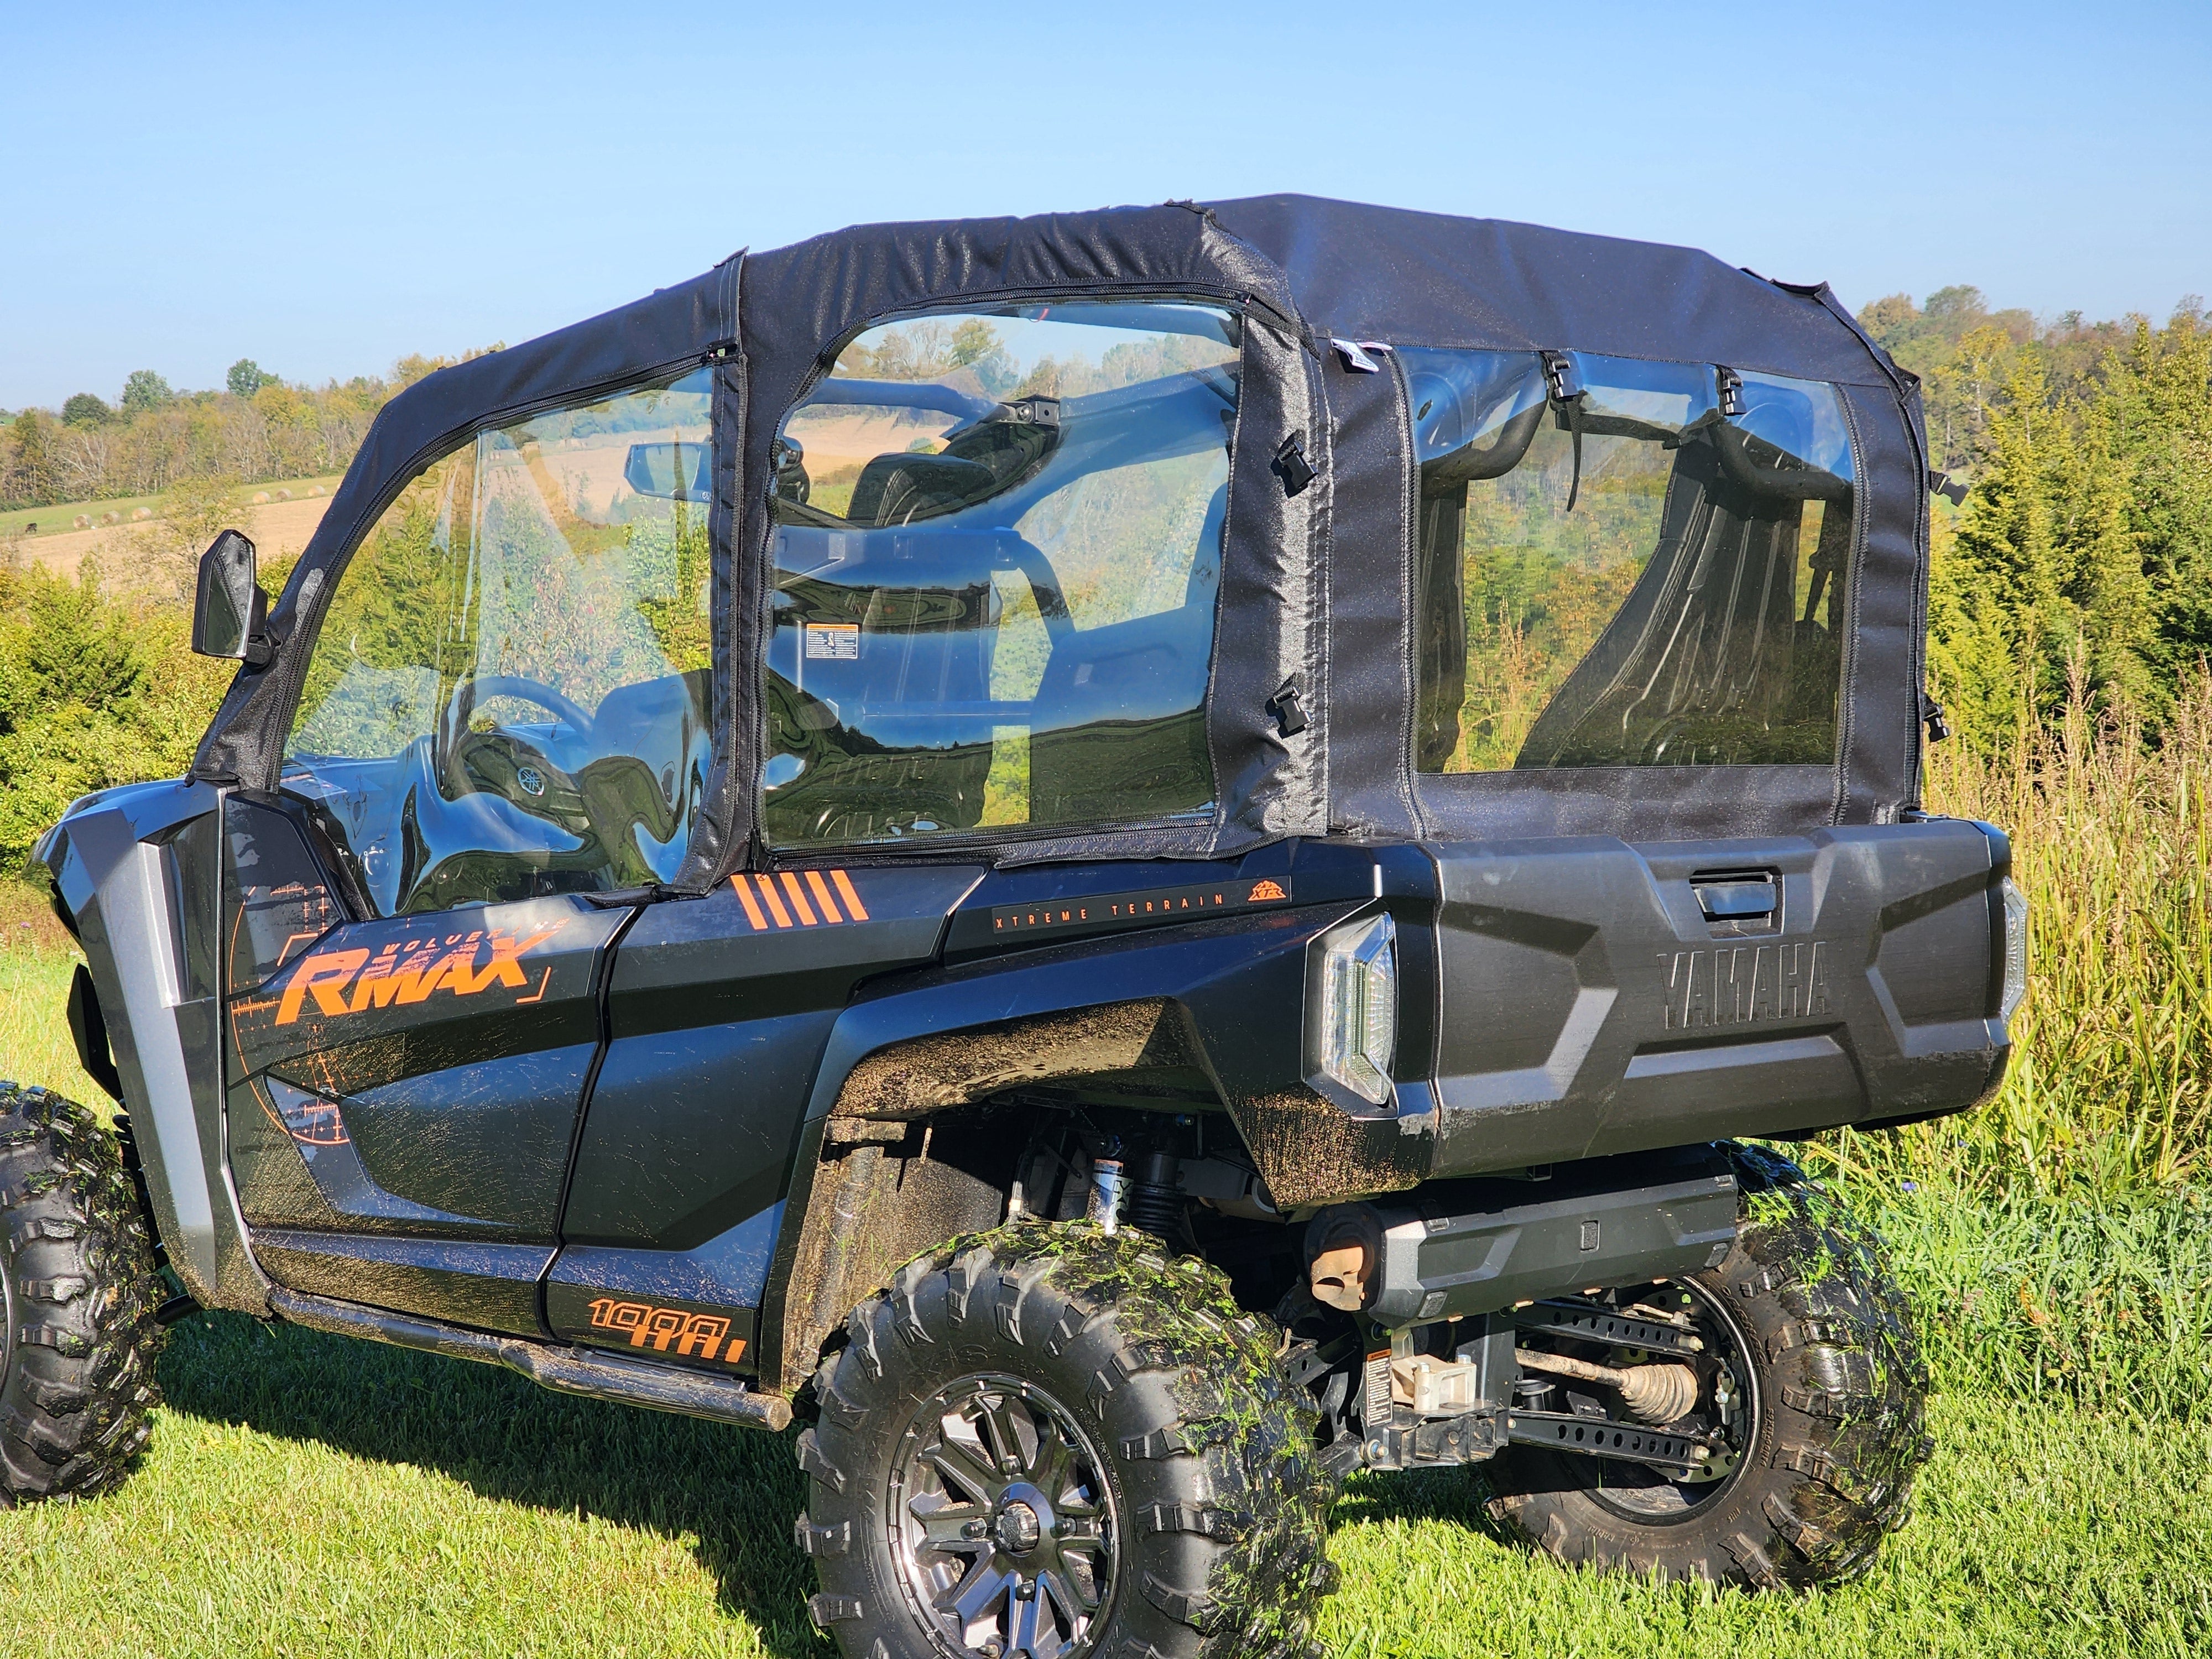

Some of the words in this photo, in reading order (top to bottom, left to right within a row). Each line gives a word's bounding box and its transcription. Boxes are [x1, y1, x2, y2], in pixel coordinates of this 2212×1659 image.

[996, 909, 1087, 928] XTREME
[1111, 894, 1223, 916] TERRAIN
[275, 930, 559, 1026] RMAX
[1656, 941, 1832, 1030] YAMAHA
